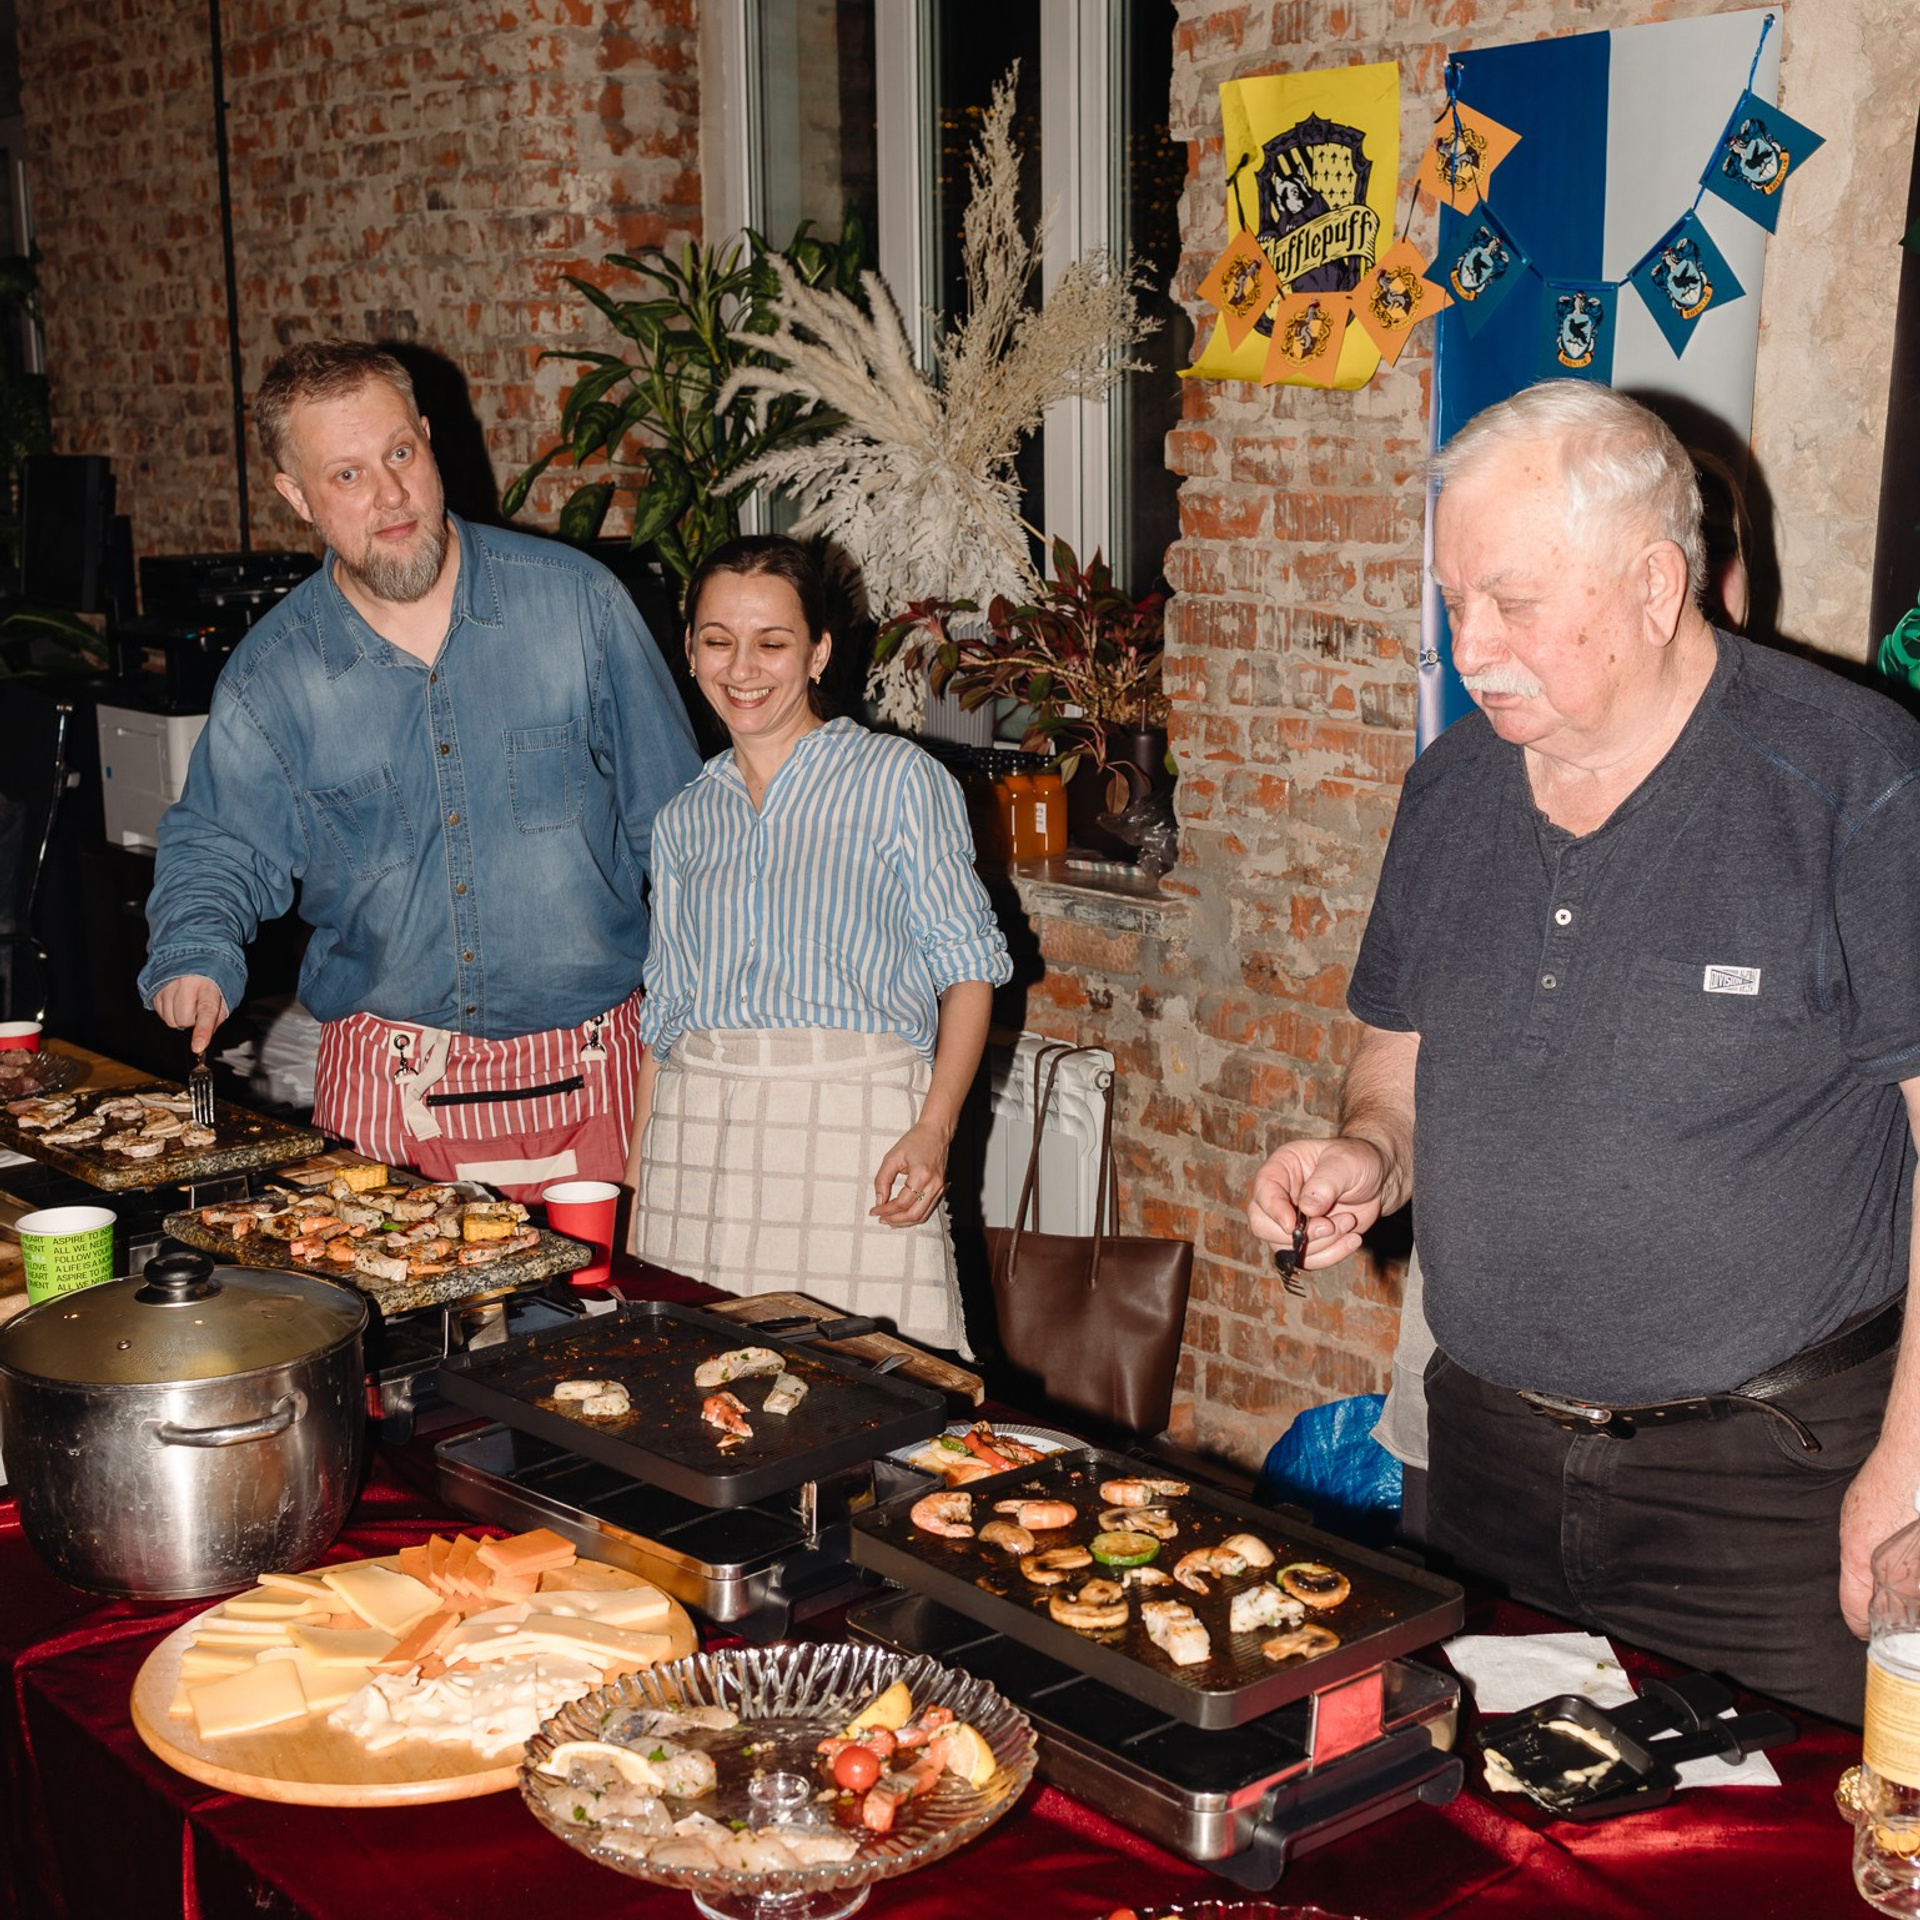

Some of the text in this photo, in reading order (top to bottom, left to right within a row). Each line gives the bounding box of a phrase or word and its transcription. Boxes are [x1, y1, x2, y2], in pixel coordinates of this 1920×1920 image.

[1263, 210, 1373, 278] ufflepuff
[1711, 970, 1743, 988] DIVISION
[53, 1235, 85, 1245] ASPIRE
[88, 1231, 99, 1240] TO
[53, 1245, 70, 1254] ALL
[73, 1243, 89, 1252] WE
[90, 1237, 109, 1249] NEED
[54, 1253, 91, 1264] FOLLOW
[93, 1246, 110, 1258] YOUR
[30, 1262, 48, 1271] LOVE
[55, 1265, 63, 1273] A
[63, 1263, 83, 1273] LIFE
[83, 1260, 91, 1269] IS
[91, 1259, 98, 1267] A
[56, 1271, 88, 1282] ASPIRE
[89, 1268, 100, 1277] TO
[57, 1282, 72, 1291] ALL
